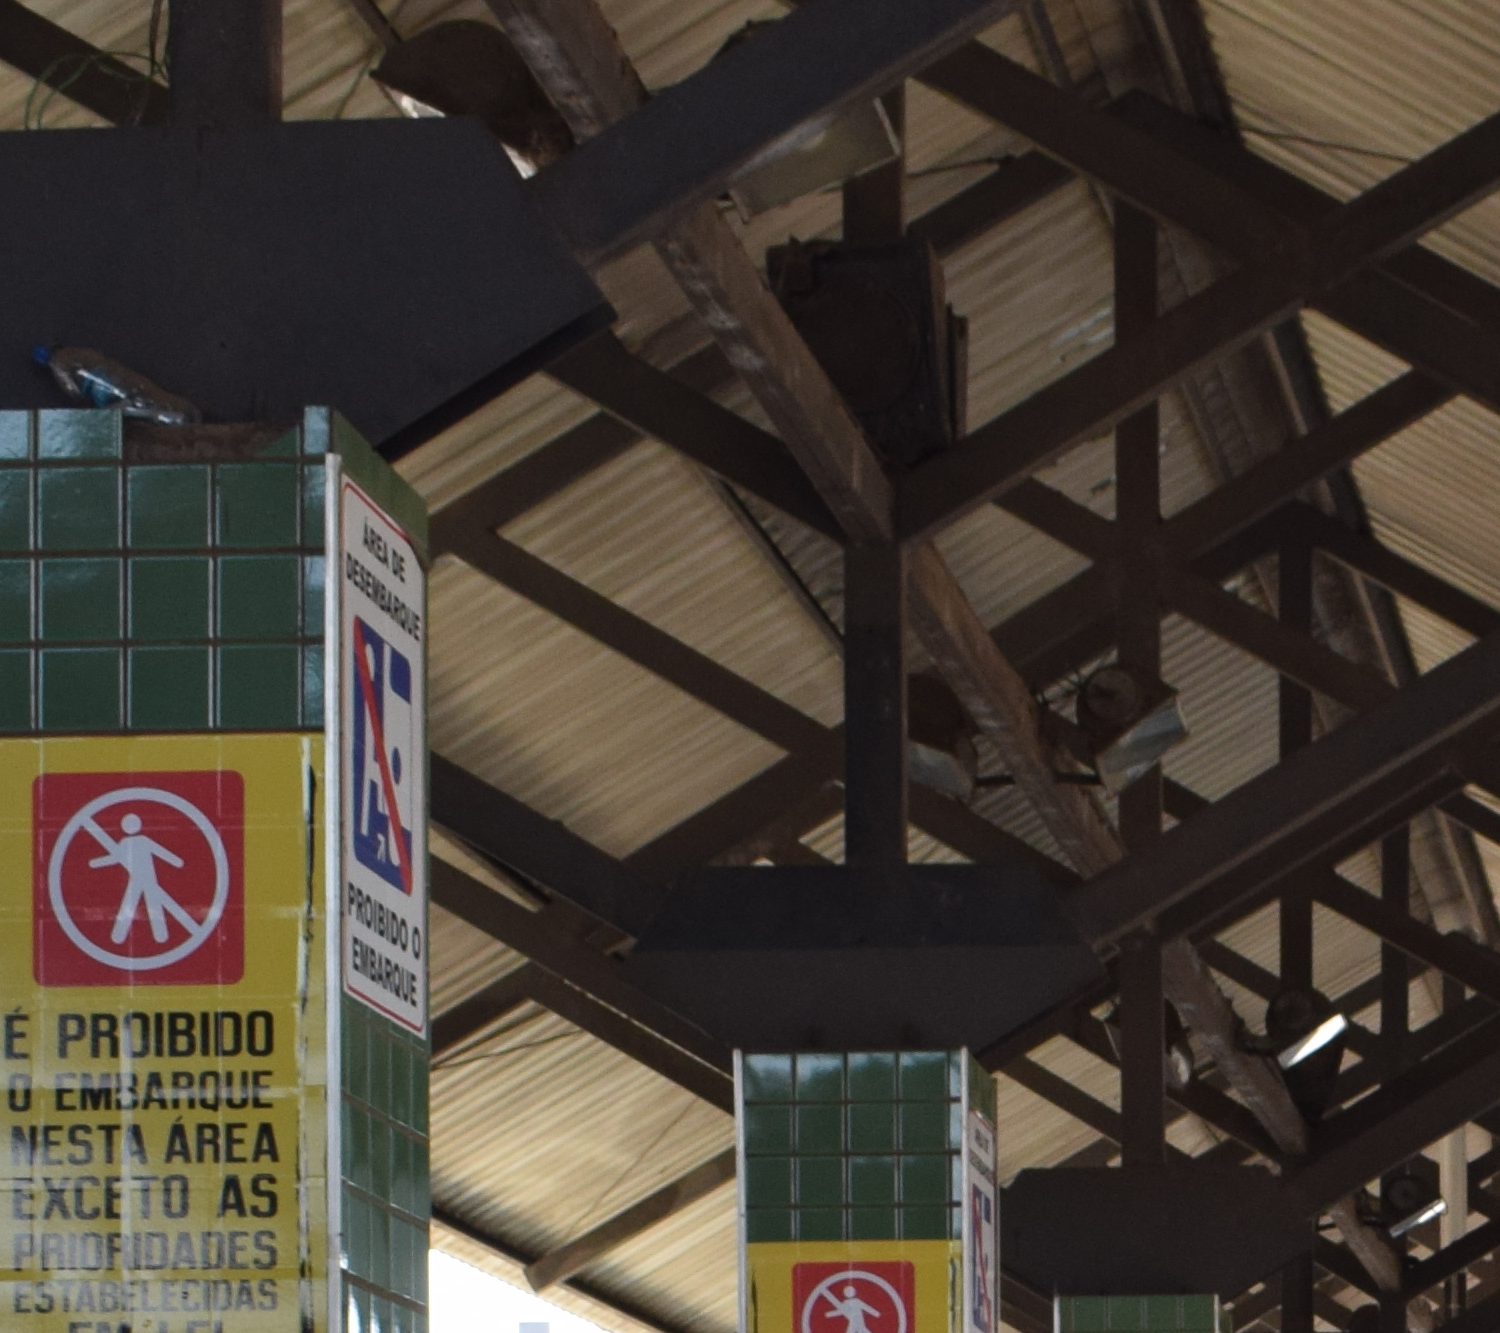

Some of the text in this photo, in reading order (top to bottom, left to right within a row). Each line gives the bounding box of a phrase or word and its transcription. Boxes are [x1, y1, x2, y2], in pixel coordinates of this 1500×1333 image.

[392, 547, 405, 584] DE
[347, 551, 420, 642] DESEMBARQUE
[348, 882, 420, 960] PROIBIDO O
[352, 936, 417, 1008] EMBARQUE
[3, 1006, 274, 1059] É PROIBIDO
[8, 1070, 273, 1113] O EMBARQUE
[10, 1115, 280, 1167] NESTA ÁREA
[11, 1173, 278, 1221] EXCETO AS
[13, 1230, 278, 1271] PRIORIDADES
[13, 1279, 278, 1313] ESTABELECIDAS
